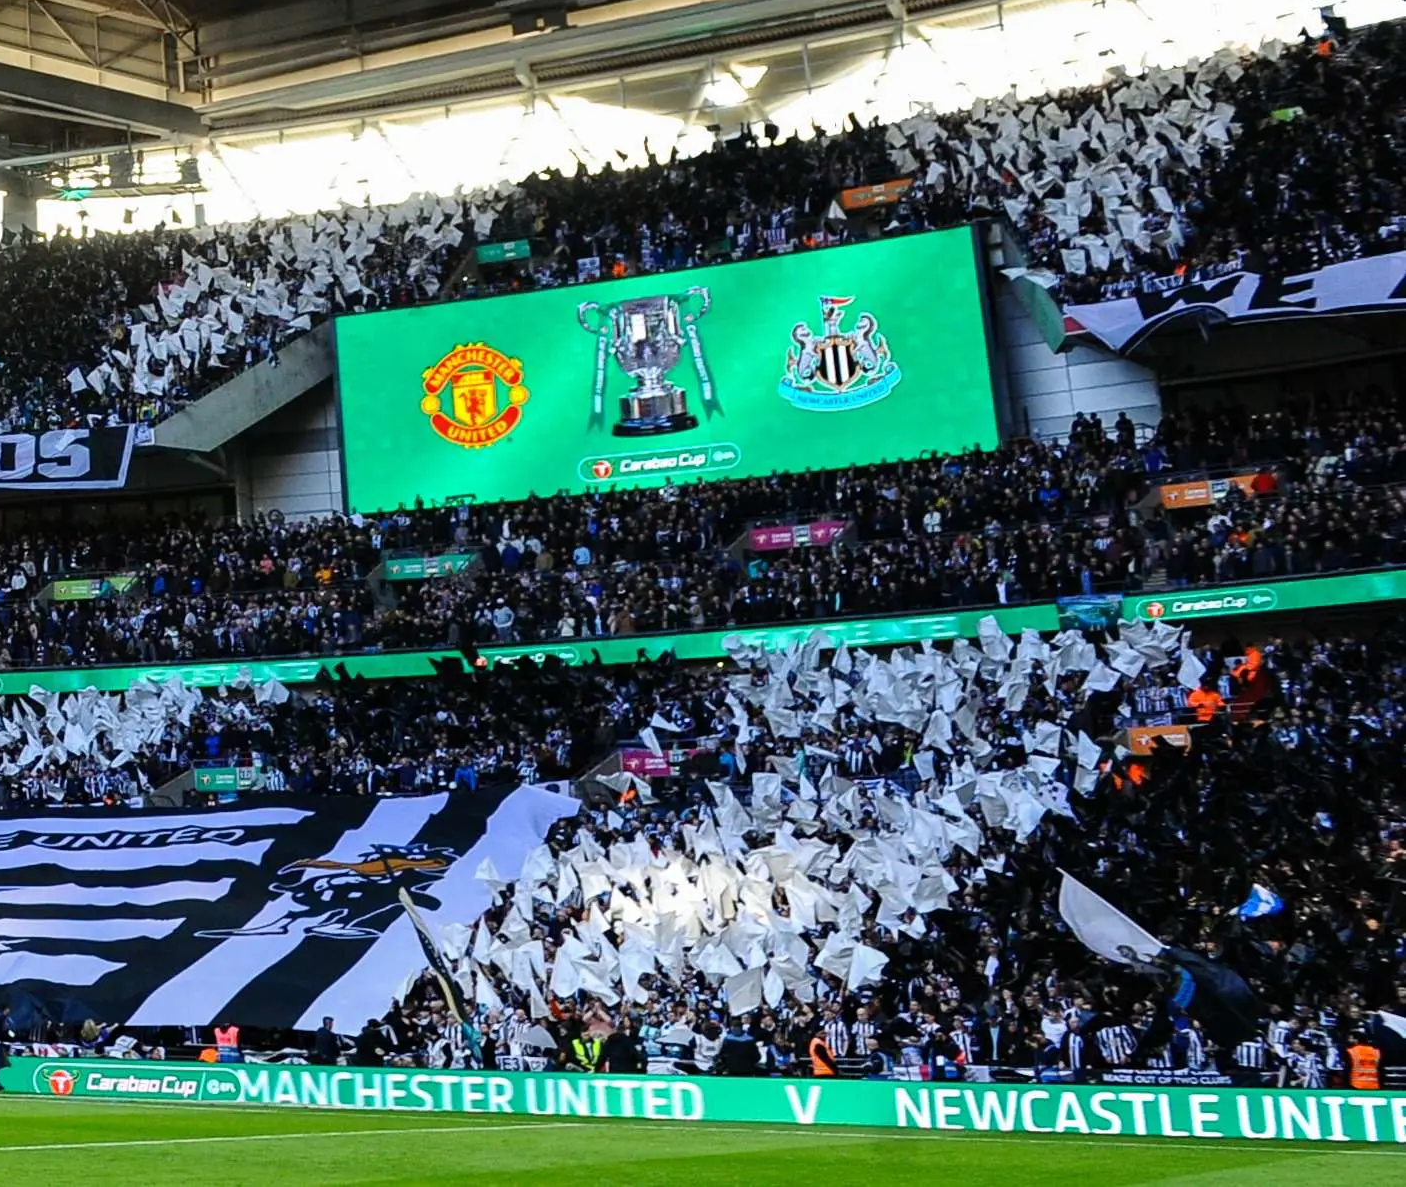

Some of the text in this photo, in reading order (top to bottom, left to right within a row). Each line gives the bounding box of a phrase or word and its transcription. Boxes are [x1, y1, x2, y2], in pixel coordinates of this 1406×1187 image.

[428, 349, 518, 388] MANCHESTER
[447, 420, 511, 442] UNITED
[619, 453, 675, 473] Carabao
[677, 450, 706, 471] Cup
[1171, 597, 1248, 613] Carabao Cup
[33, 827, 247, 851] UNITED
[86, 1071, 160, 1091] Carabao
[161, 1074, 198, 1099] Cup
[240, 1070, 515, 1114] MANCHESTER
[530, 1082, 705, 1121] UNITED
[786, 1085, 822, 1126] V
[895, 1087, 1221, 1138] NEWCASTLE
